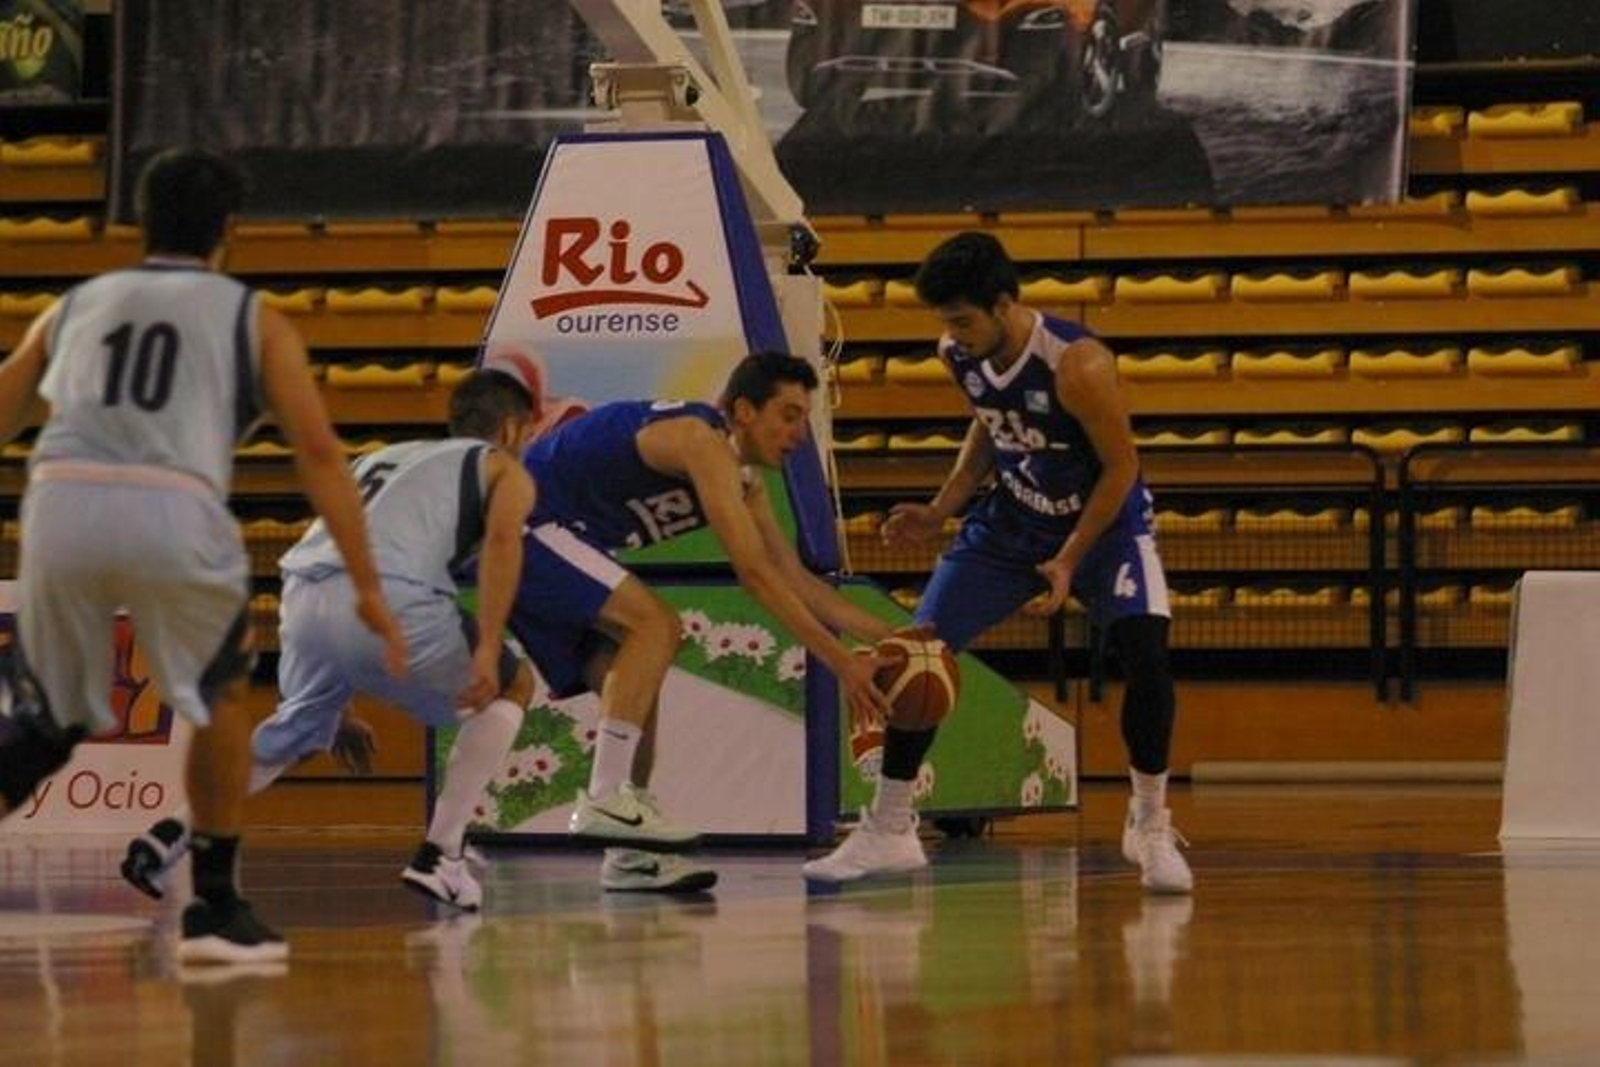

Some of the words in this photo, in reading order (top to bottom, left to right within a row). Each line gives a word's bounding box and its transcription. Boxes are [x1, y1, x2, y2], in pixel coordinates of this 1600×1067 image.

[541, 217, 683, 287] Rio
[557, 312, 678, 334] ourense
[102, 321, 181, 412] 10
[1113, 562, 1138, 597] 4
[24, 781, 53, 818] y
[67, 770, 164, 809] Ocio
